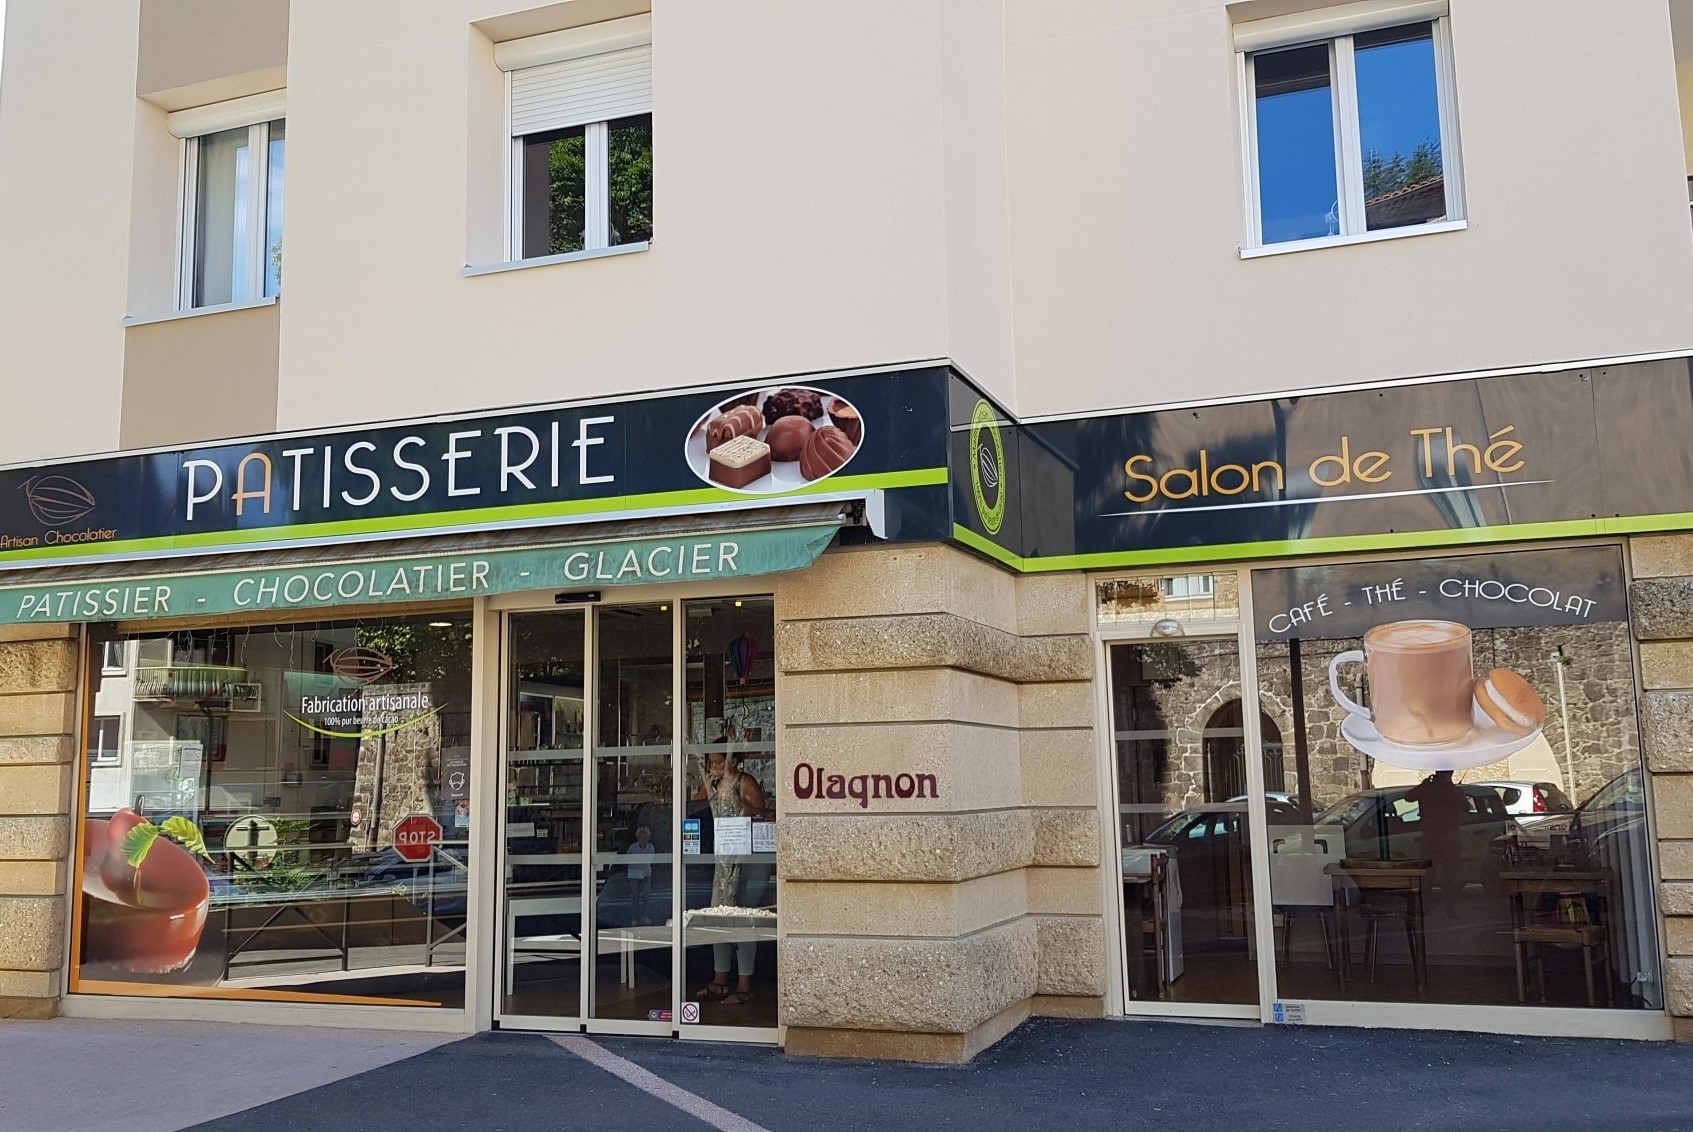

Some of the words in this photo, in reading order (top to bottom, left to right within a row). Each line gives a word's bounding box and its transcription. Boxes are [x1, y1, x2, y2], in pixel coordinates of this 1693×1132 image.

[182, 415, 615, 521] PATISSERIE
[1123, 449, 1285, 503] Salon
[1308, 436, 1392, 487] de
[1410, 424, 1525, 478] Thé
[0, 534, 38, 549] Artisan
[44, 528, 118, 545] Chocolatier
[16, 585, 171, 619] PATISSIER
[233, 560, 490, 606] CHOCOLATIER
[564, 541, 739, 581] GLACIER
[1268, 593, 1333, 633] CAFÉ
[1361, 577, 1406, 605] THÉ
[1438, 578, 1597, 619] CHOCOLAT
[301, 695, 365, 714] Fabrication
[369, 691, 429, 711] artisanale
[324, 716, 341, 726] 100%
[341, 717, 352, 728] pur
[352, 715, 373, 725] beurre
